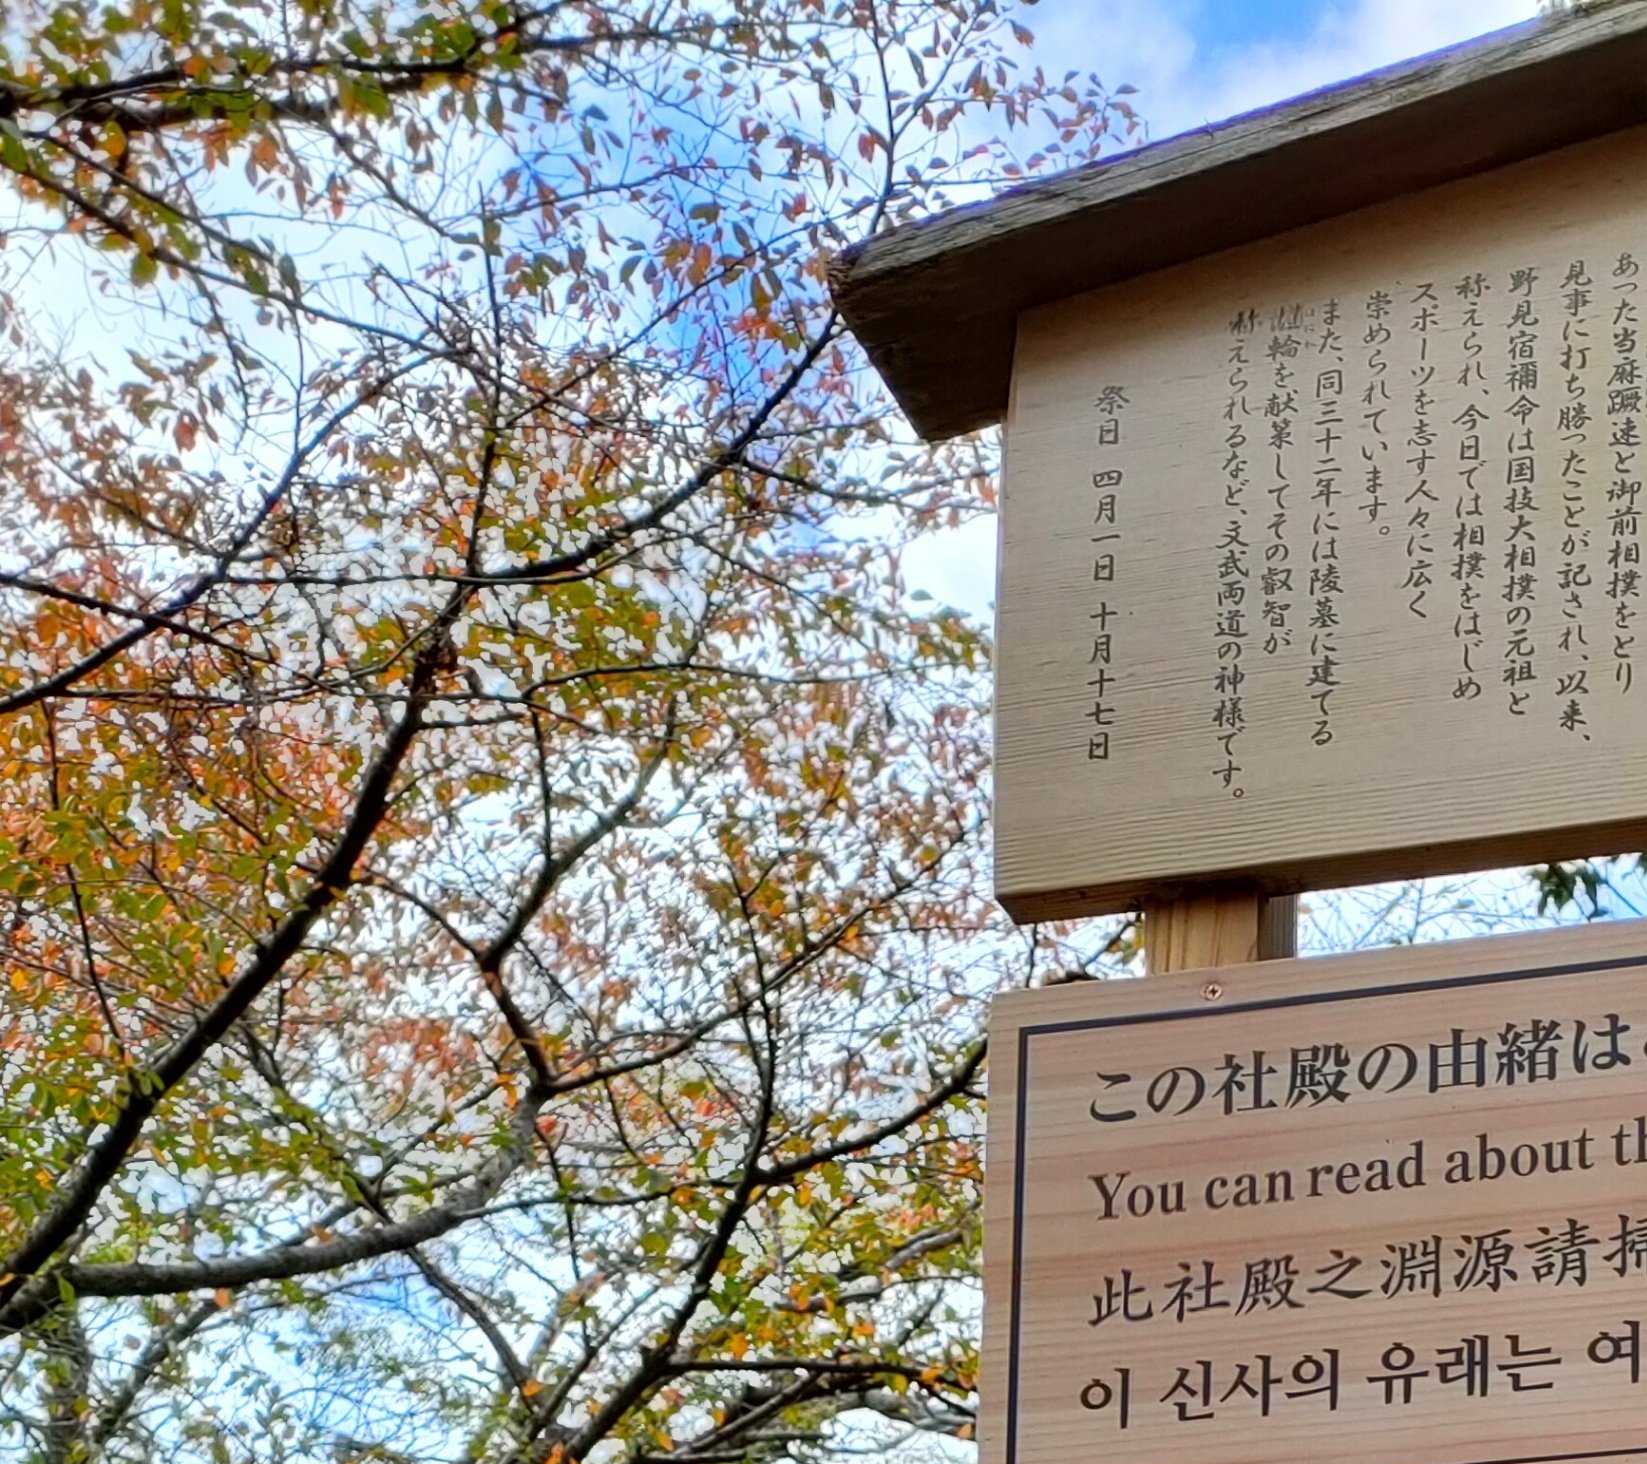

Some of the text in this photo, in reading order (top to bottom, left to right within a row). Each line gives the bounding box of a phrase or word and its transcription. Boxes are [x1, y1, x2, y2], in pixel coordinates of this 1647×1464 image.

[1358, 289, 1393, 535] 崇められています。
[1400, 282, 1440, 619] スポーツを志す人々に広く
[1450, 272, 1491, 700] 称えられ、今日では相撲をはじめ
[1084, 385, 1130, 760] 祭日 四月一日 十月十七日
[1087, 1170, 1186, 1222] You
[1204, 1163, 1295, 1212] can
[1306, 1139, 1427, 1198] read
[1444, 1132, 1596, 1185] about
[1080, 1367, 1131, 1430] 이
[1159, 1348, 1341, 1422] 신사의
[1365, 1333, 1563, 1406] 유래는
